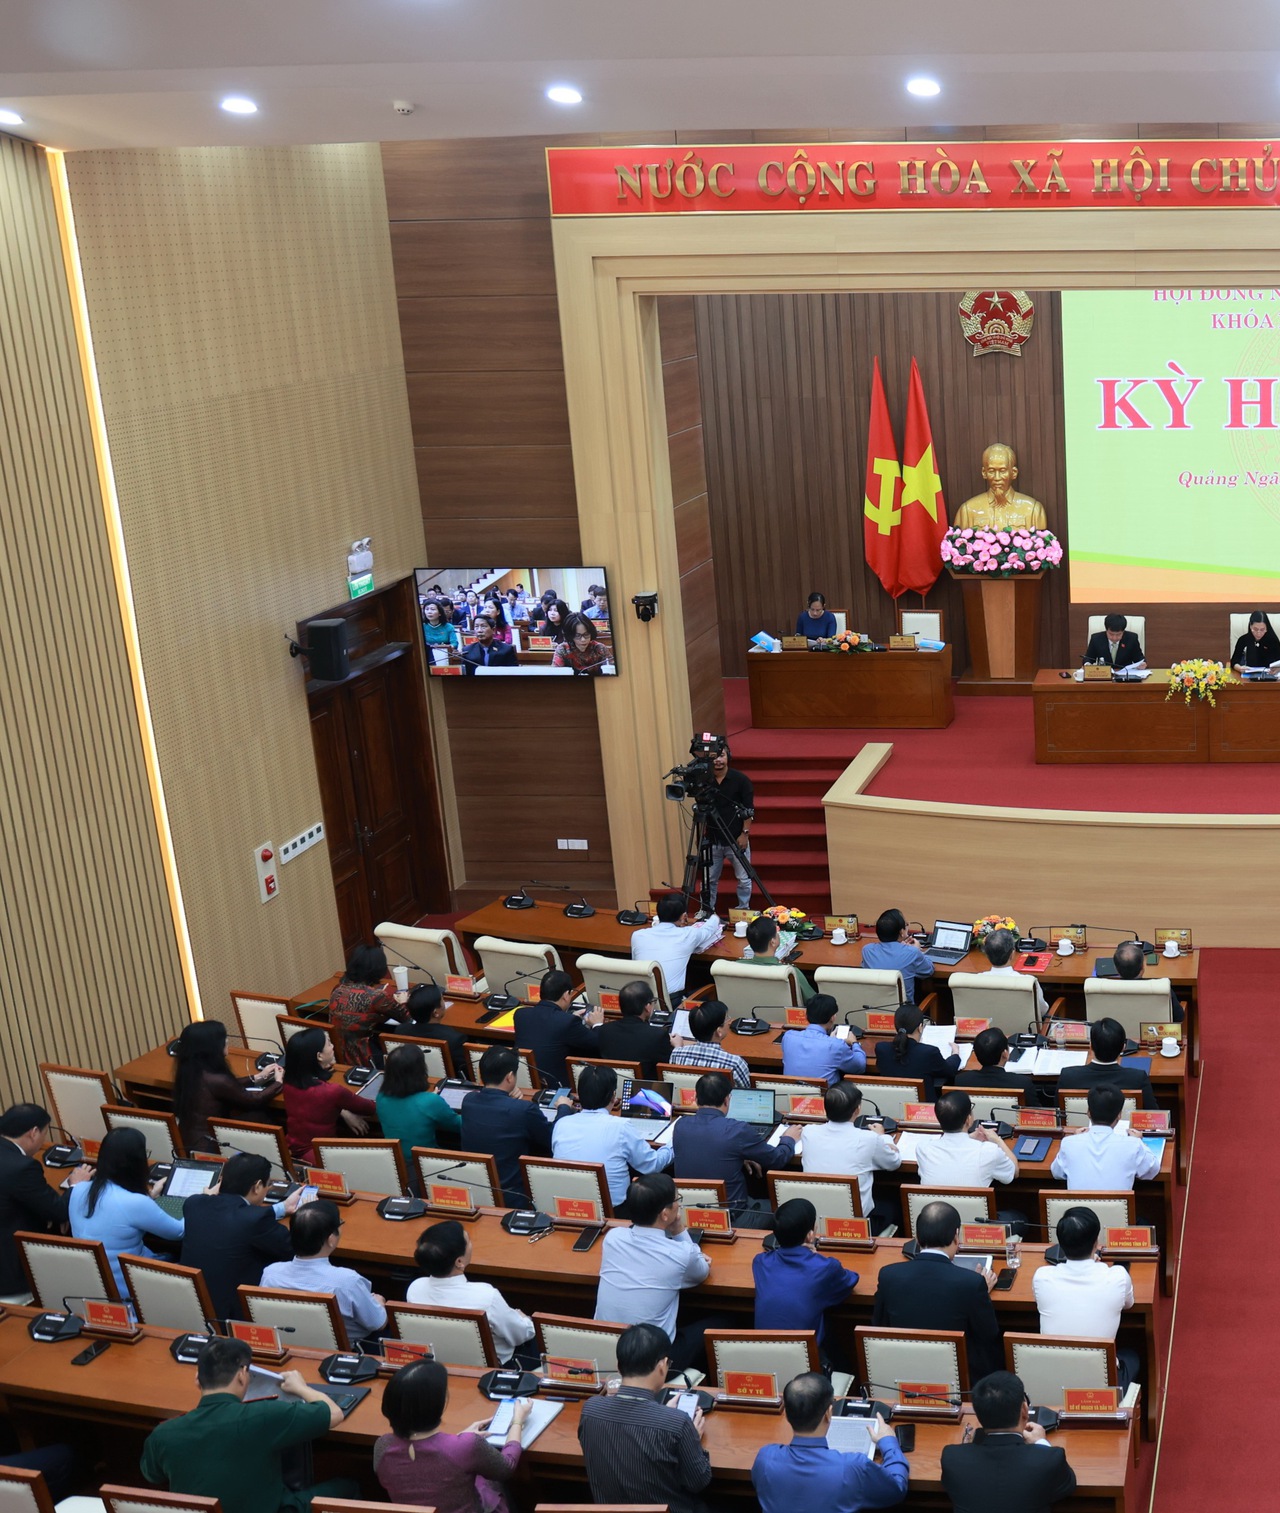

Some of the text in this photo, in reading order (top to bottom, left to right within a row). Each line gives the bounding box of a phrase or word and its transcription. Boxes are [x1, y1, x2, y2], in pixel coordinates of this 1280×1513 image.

[615, 151, 735, 199] NƯỚC
[758, 149, 877, 203] CỘNG
[898, 148, 992, 194] HÒA
[1011, 148, 1071, 194] XÃ
[1091, 146, 1171, 200] HỘI
[1191, 145, 1280, 193] CHỦ
[1212, 308, 1275, 330] KHÓA
[1095, 360, 1204, 431] KỲ
[1178, 470, 1239, 488] Quảng
